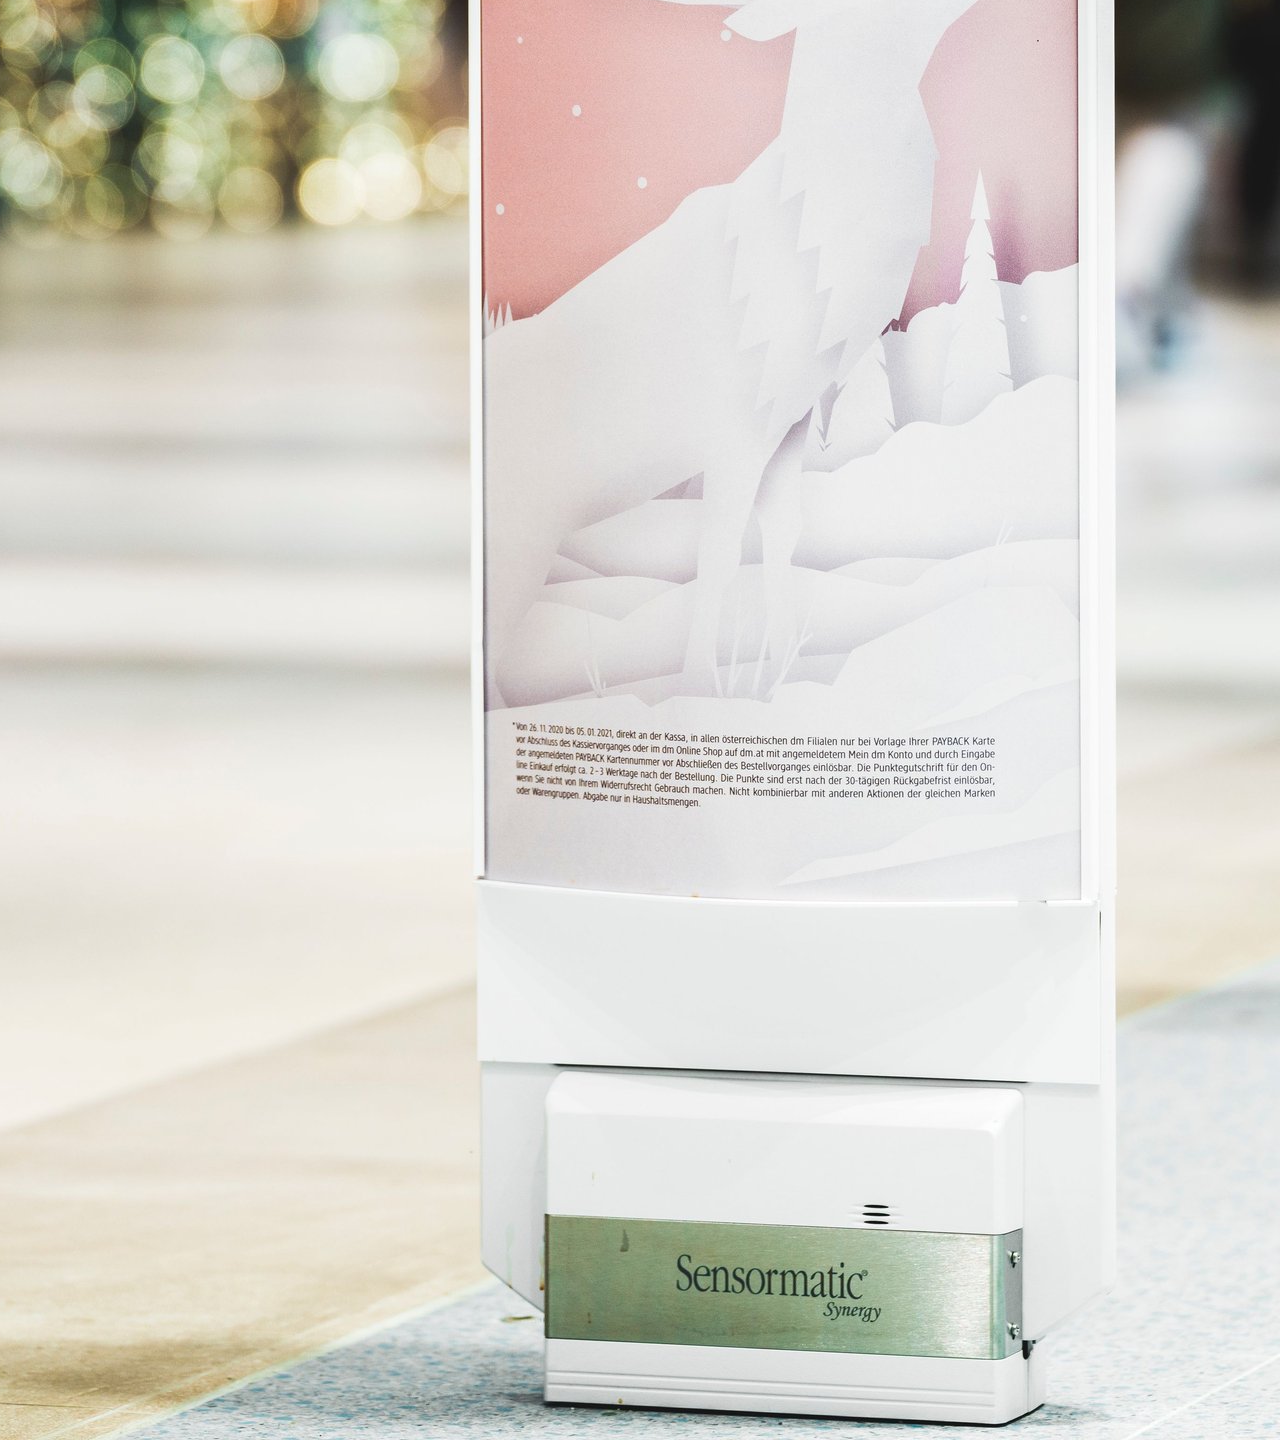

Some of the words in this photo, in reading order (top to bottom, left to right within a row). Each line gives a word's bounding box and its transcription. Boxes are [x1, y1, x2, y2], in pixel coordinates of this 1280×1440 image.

[616, 729, 637, 739] direkt
[649, 731, 662, 740] der
[690, 733, 698, 742] in
[700, 734, 720, 743] allen
[721, 734, 788, 745] österreichischen
[790, 736, 805, 745] dm
[807, 736, 838, 746] Filialen
[858, 737, 871, 746] bei
[873, 737, 906, 747] Vorlage
[908, 737, 929, 746] Ihrer
[932, 737, 970, 745] PAYBACK
[972, 736, 996, 745] Karte
[632, 743, 649, 752] oder
[650, 744, 660, 753] im
[662, 745, 674, 754] dm
[676, 745, 701, 755] Online
[702, 747, 723, 758] Shop
[725, 748, 738, 757] auf
[739, 748, 764, 757] dm.at
[766, 749, 780, 758] mit
[782, 750, 846, 760] angemeldetem
[848, 750, 869, 759] Mein
[871, 750, 886, 759] dm
[888, 750, 914, 759] Konto
[915, 750, 932, 759] und
[934, 750, 959, 759] durch
[961, 749, 996, 760] Eingabe
[606, 754, 661, 766] Kartennummer
[675, 758, 722, 769] Abschließen
[724, 761, 738, 770] des
[740, 761, 811, 773] Bestellvorganges
[857, 763, 871, 772] Die
[873, 763, 944, 773] Punktegutschrift
[946, 763, 959, 772] für
[961, 763, 978, 771] den
[605, 767, 639, 779] Werktage
[640, 770, 658, 779] nach
[659, 771, 673, 780] der
[720, 774, 734, 782] Die
[736, 774, 765, 783] Punkte
[766, 775, 784, 784] sind
[786, 775, 803, 784] erst
[805, 776, 826, 784] nach
[828, 776, 843, 785] der
[845, 776, 891, 786] 30-tägigen
[893, 776, 951, 786] Rückgabefrist
[953, 776, 996, 786] einlösbar,
[600, 780, 652, 792] Widerrufsrecht
[654, 783, 690, 793] Gebrauch
[729, 786, 750, 796] Nicht
[753, 787, 809, 797] kombinierbar
[811, 789, 826, 798] mit
[828, 789, 864, 798] anderen
[866, 789, 904, 798] Aktionen
[907, 789, 921, 798] der
[924, 789, 961, 799] gleichen
[964, 788, 996, 797] Marken
[623, 794, 631, 803] in
[823, 1302, 881, 1322] Synergy
